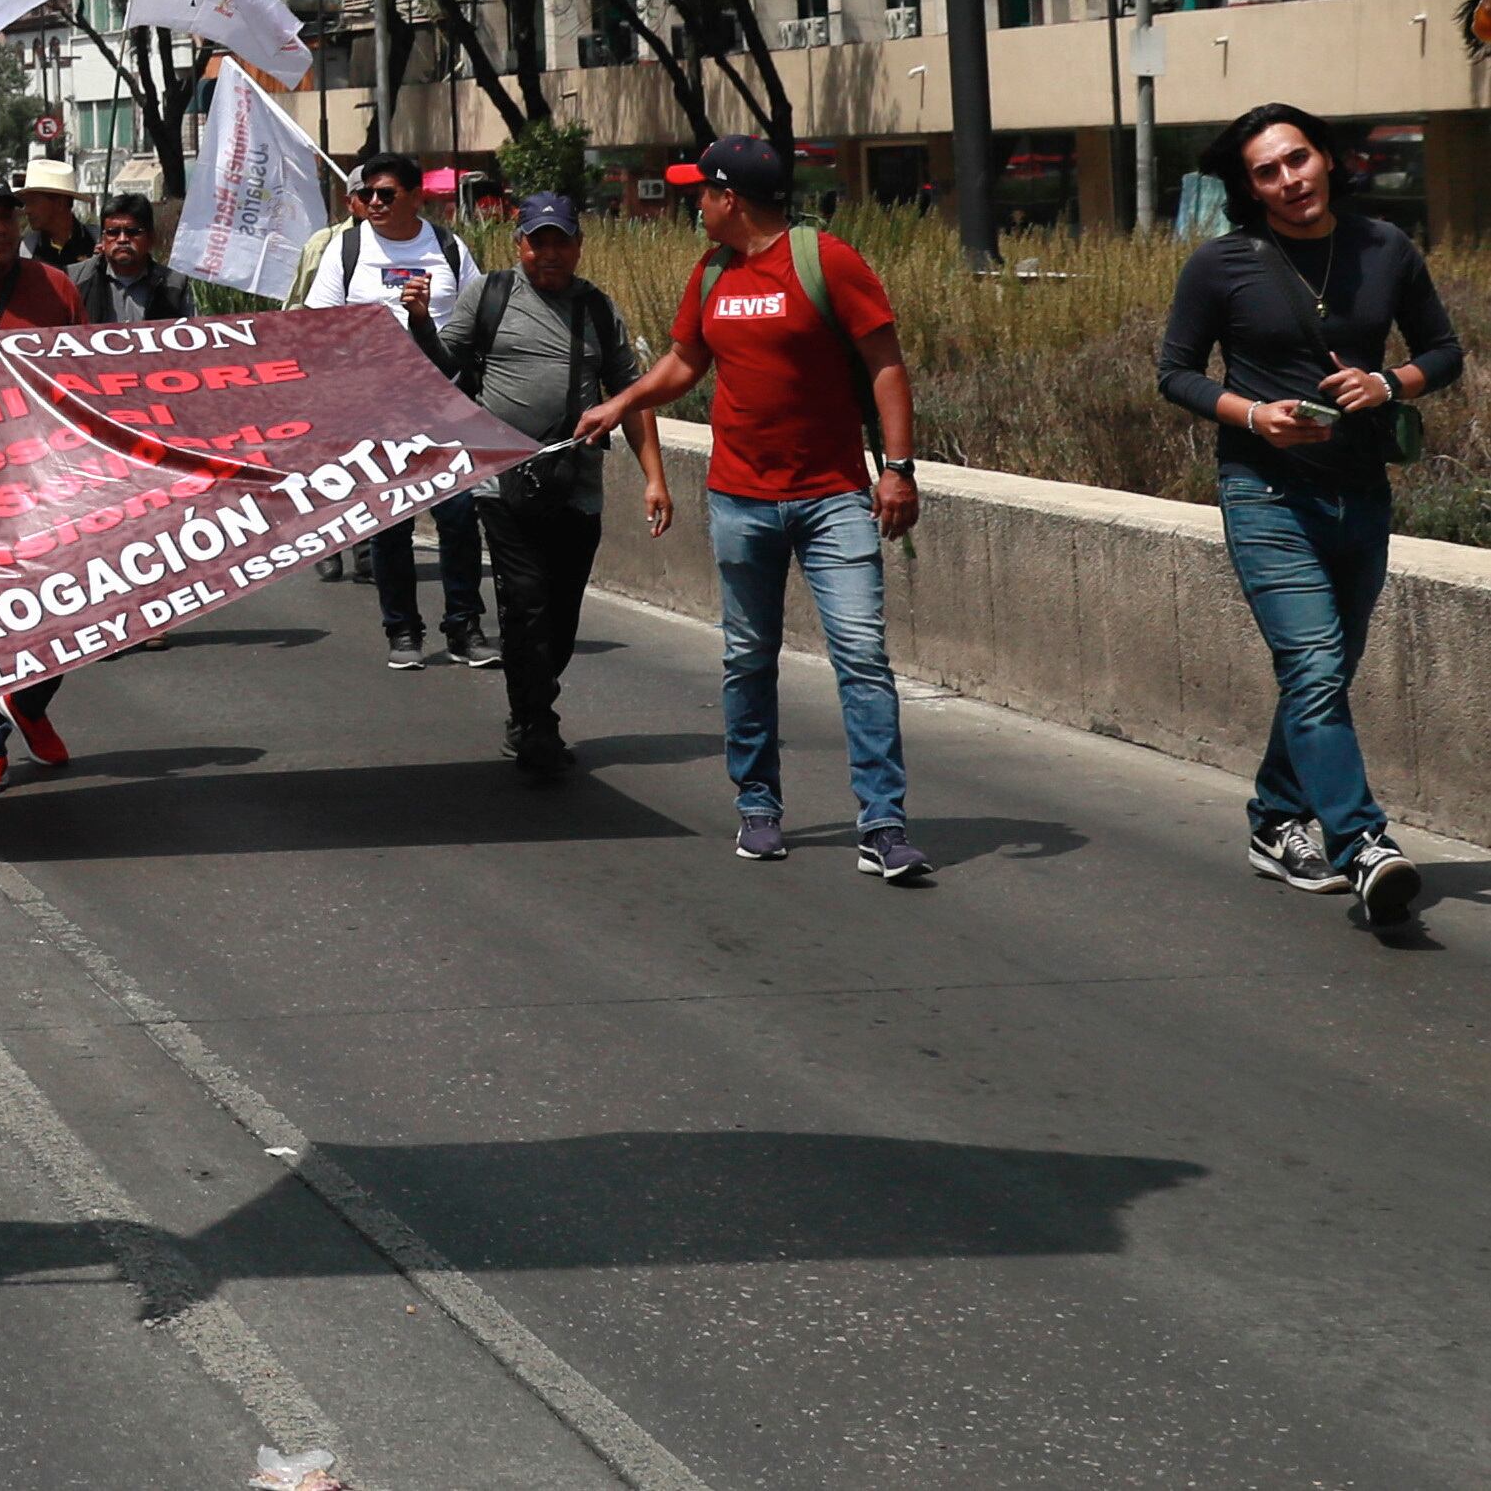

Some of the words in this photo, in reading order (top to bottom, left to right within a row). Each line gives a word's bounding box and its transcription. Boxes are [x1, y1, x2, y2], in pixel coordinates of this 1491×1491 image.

[49, 359, 309, 406] AFORE
[51, 612, 131, 666] LEY
[137, 581, 227, 630] DEL
[228, 501, 381, 589] ISSSTE
